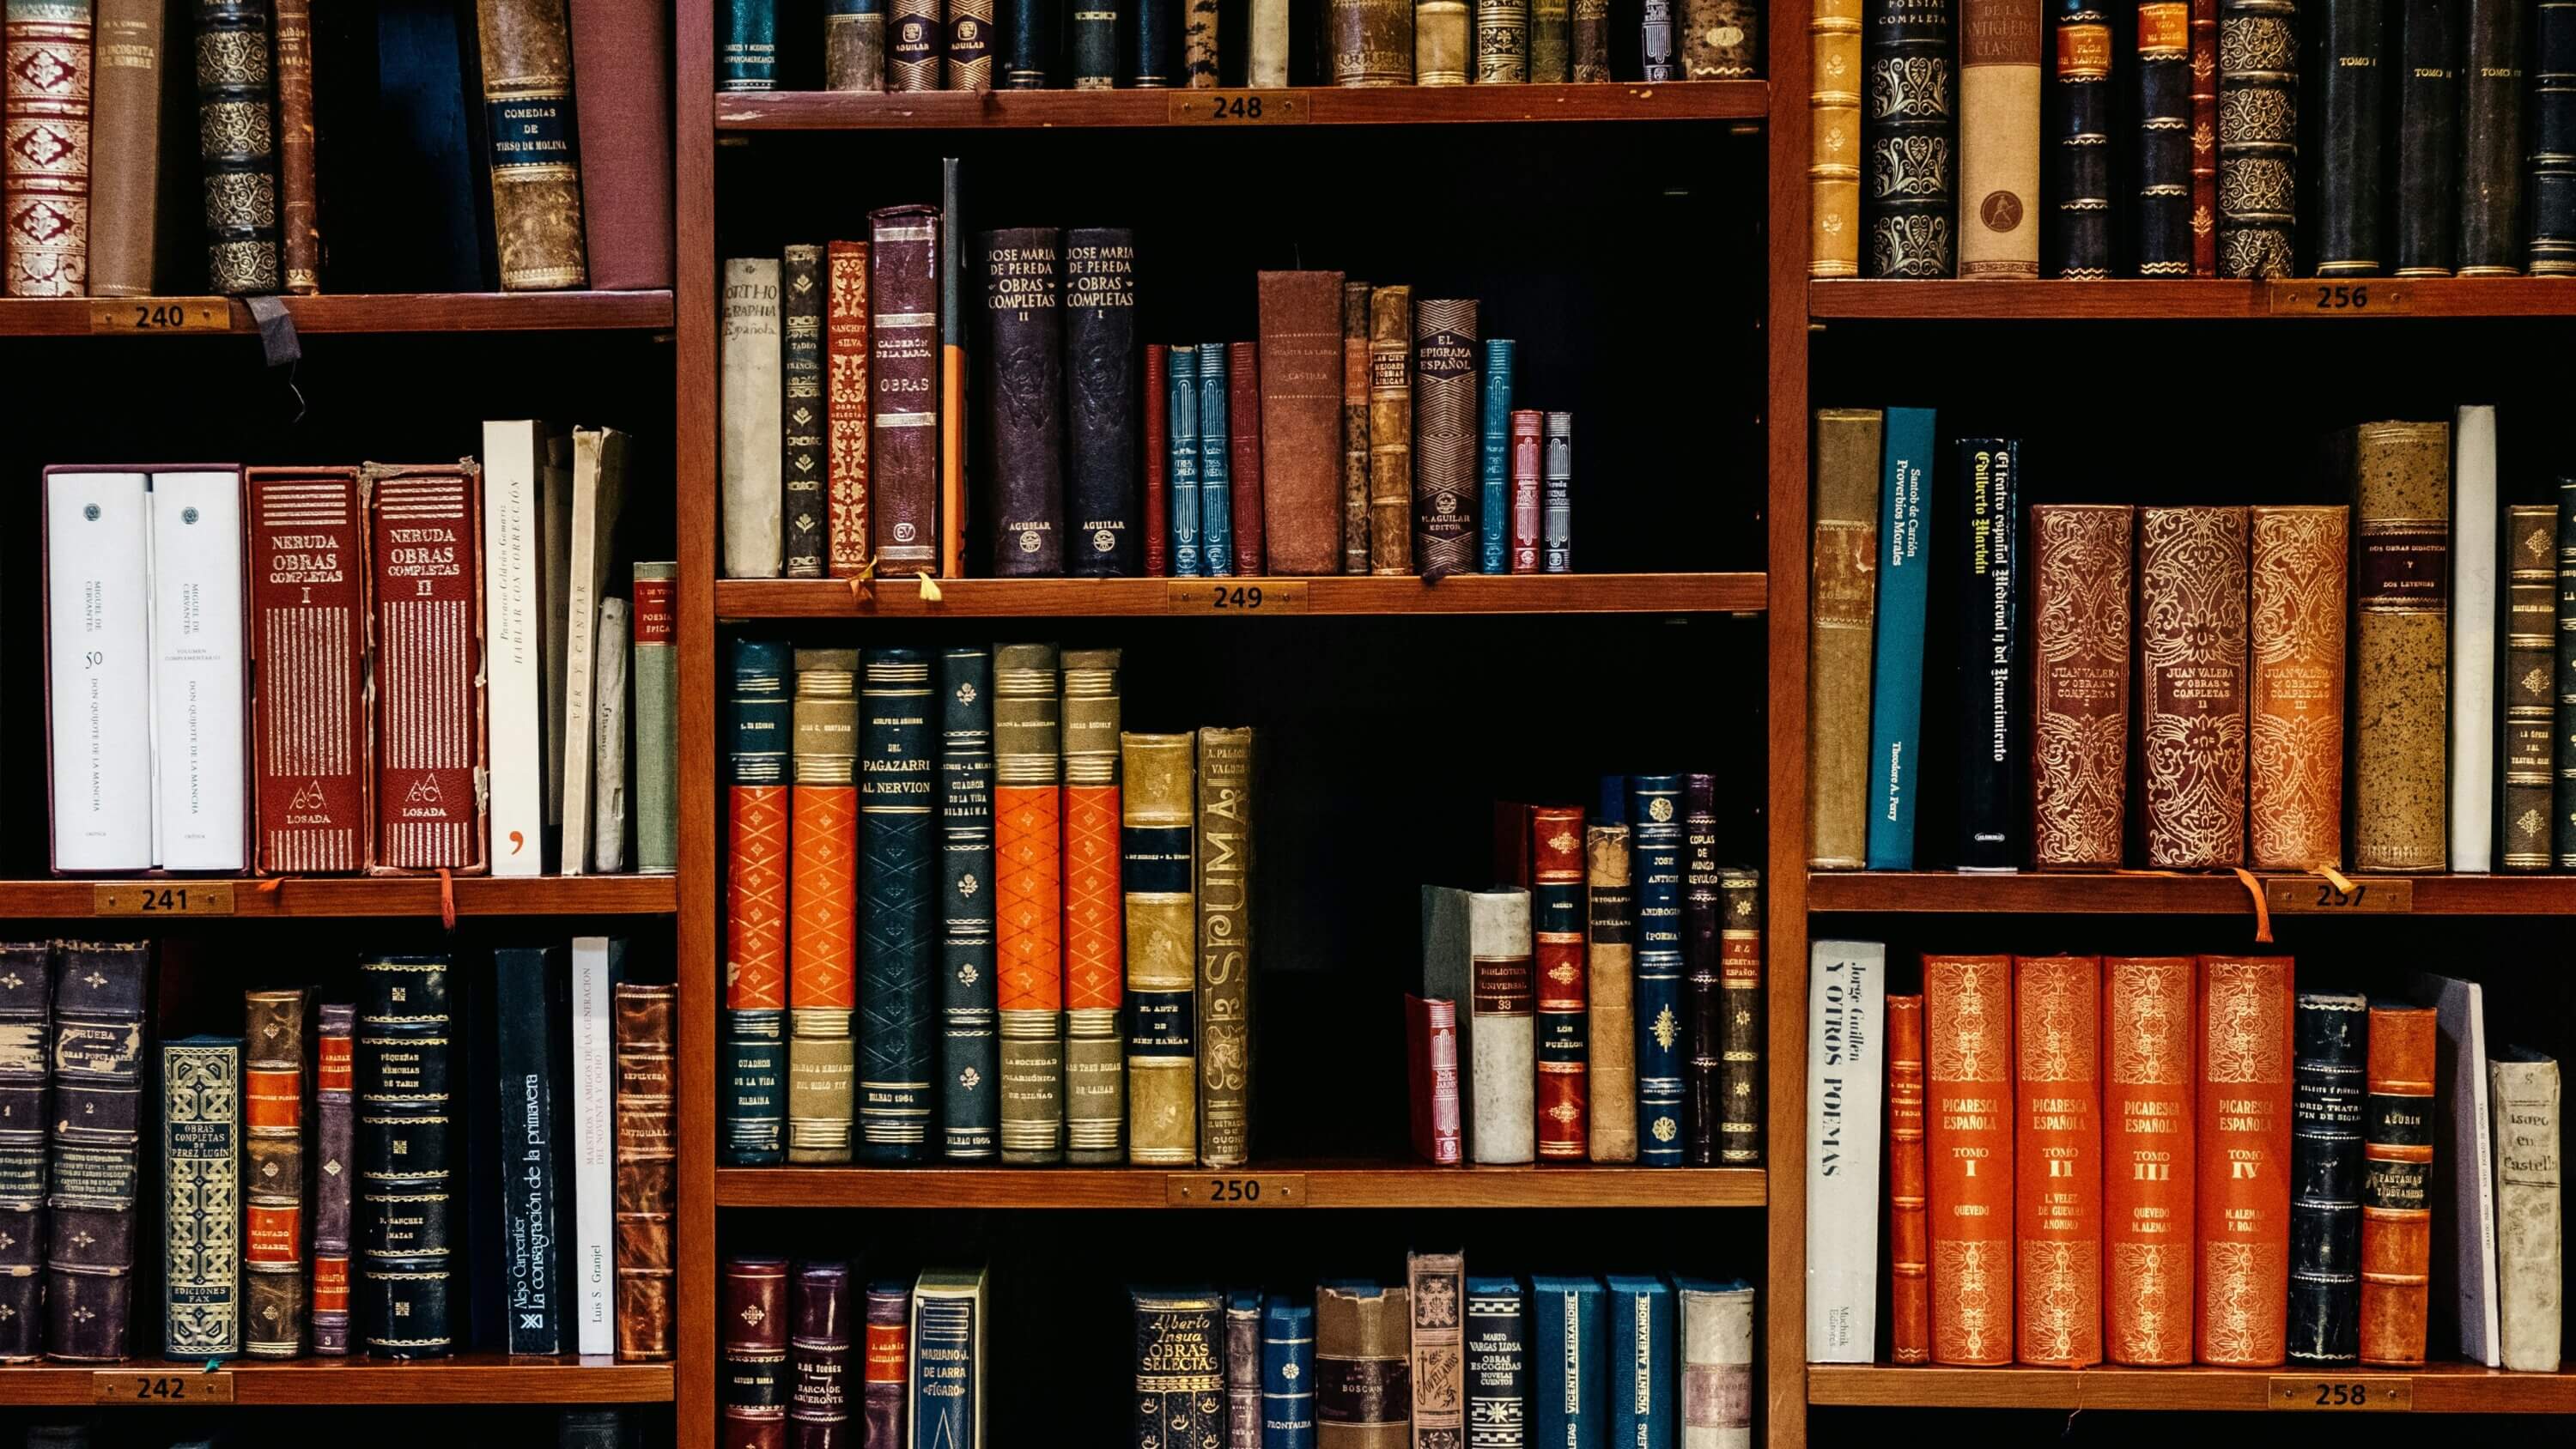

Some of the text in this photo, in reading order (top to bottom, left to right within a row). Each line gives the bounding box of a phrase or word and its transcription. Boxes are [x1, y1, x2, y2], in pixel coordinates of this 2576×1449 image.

[1984, 5, 2023, 16] DE LA
[896, 43, 930, 52] AGUILAR
[951, 41, 985, 50] AGUILAR
[504, 108, 556, 118] COMEDIAS
[1213, 96, 1262, 118] 248
[523, 124, 538, 134] DE
[495, 139, 567, 151] TIRSO DE MOLINA
[987, 248, 1055, 262] JOSE MARIA
[1066, 246, 1134, 260] JOSE MARIA
[990, 263, 1053, 276] DE PEREDA
[1070, 261, 1132, 274] DE PEREDA
[999, 279, 1043, 293] OBRAS
[1078, 277, 1121, 291] OBRAS
[988, 294, 1055, 309] COMPLETAS
[1067, 293, 1134, 307] COMPLETAS
[2318, 287, 2367, 308] 256
[136, 306, 184, 329] 240
[878, 338, 928, 349] CALDERÓN
[1438, 335, 1454, 345] EL
[1420, 347, 1472, 358] EPIGRAMA
[1420, 357, 1471, 371] ESPAÑOL
[880, 379, 929, 392] OBRAS
[1994, 452, 2008, 469] El
[1995, 472, 2008, 510] teatro
[1893, 459, 1909, 567] Proverbios Morales
[1906, 468, 1921, 557] Santob de Carrión
[1973, 451, 1990, 574] Edilberto Marbán
[1009, 521, 1051, 531] AGUILAR
[1083, 520, 1126, 530] AGUILAR
[271, 536, 338, 550] NERUDA
[391, 529, 456, 543] NERUDA
[1992, 514, 2008, 564] español
[272, 555, 337, 571] OBRAS
[391, 548, 454, 564] OBRAS
[270, 570, 343, 585] COMPLETAS
[388, 564, 459, 577] COMPLETAS
[302, 587, 311, 603] I
[416, 579, 433, 597] II
[1213, 587, 1262, 609] 249
[1992, 569, 2009, 631] Medieval
[575, 585, 585, 653] CANTAR
[86, 652, 103, 669] 50
[1994, 646, 2007, 664] del
[2051, 668, 2120, 679] JUAN VALERA
[2166, 668, 2233, 679] JUAN VALERA
[2072, 679, 2106, 688] OBRAS
[188, 681, 197, 701] DON
[2057, 688, 2116, 699] COMPLETAS
[2173, 688, 2231, 698] COMPLETAS
[573, 689, 582, 720] VER
[91, 701, 100, 741] QUIJOTE
[1993, 668, 2008, 761] Renacimiento
[188, 704, 197, 743] QUIJOTE
[92, 743, 100, 756] DE
[190, 745, 197, 760] DE
[863, 760, 931, 772] PAGAZARRI
[862, 782, 931, 794] AL NERVION
[1888, 741, 1902, 822] Theodore A. Perry
[403, 807, 447, 816] LOSADA
[287, 815, 331, 824] LOSADA
[1690, 835, 1715, 845] COPLAS
[1698, 848, 1708, 858] DE
[142, 888, 186, 910] 241
[1847, 961, 1866, 1062] Jorge Guillén
[1821, 961, 1844, 1177] Y OTROS POEMAS
[86, 1102, 94, 1114] 2
[1942, 1099, 1998, 1113] PICARESCA
[2032, 1099, 2087, 1113] PICARESCA
[2124, 1100, 2179, 1115] PICARESCA
[2219, 1100, 2274, 1114] PICARESCA
[1943, 1115, 1996, 1130] ESPAÑOLA
[2033, 1115, 2086, 1131] ESPAÑOLA
[2125, 1118, 2178, 1133] ESPAÑOLA
[2220, 1117, 2272, 1131] ESPAÑOLA
[174, 1133, 225, 1142] COMPLETAS
[1952, 1148, 1989, 1158] TOMO
[2042, 1148, 2079, 1158] TOMO
[2133, 1150, 2170, 1161] TOMO
[2227, 1149, 2263, 1160] TOMO
[1965, 1160, 1977, 1177] I
[2049, 1160, 2074, 1177] II
[2133, 1163, 2171, 1180] III
[2232, 1161, 2262, 1179] IV
[523, 1074, 550, 1309] La consagración de la primavera
[1211, 1180, 1260, 1201] 250
[1953, 1205, 1990, 1216] QUEVEDO
[2134, 1208, 2170, 1219] QUEVEDO
[513, 1216, 530, 1309] Alejo Carpentier
[591, 1245, 603, 1283] Granjel
[592, 1302, 601, 1323] Luis
[1149, 1313, 1210, 1330] Alberto
[1157, 1330, 1202, 1343] Insua
[1149, 1343, 1209, 1357] OBRAS
[1469, 1342, 1522, 1352] VARGAS LLOSA
[1567, 1295, 1577, 1413] VICENTE ALEIXANDRE
[1637, 1296, 1648, 1414] VICENTE ALEIXANDRE
[1143, 1357, 1218, 1372] SELECTAS
[1471, 1362, 1522, 1371] ESCOGIDAS
[924, 1366, 967, 1378] DE LARRA
[137, 1378, 185, 1398] 242
[923, 1381, 965, 1397] «FÍGARO»
[2316, 1384, 2365, 1405] 258
